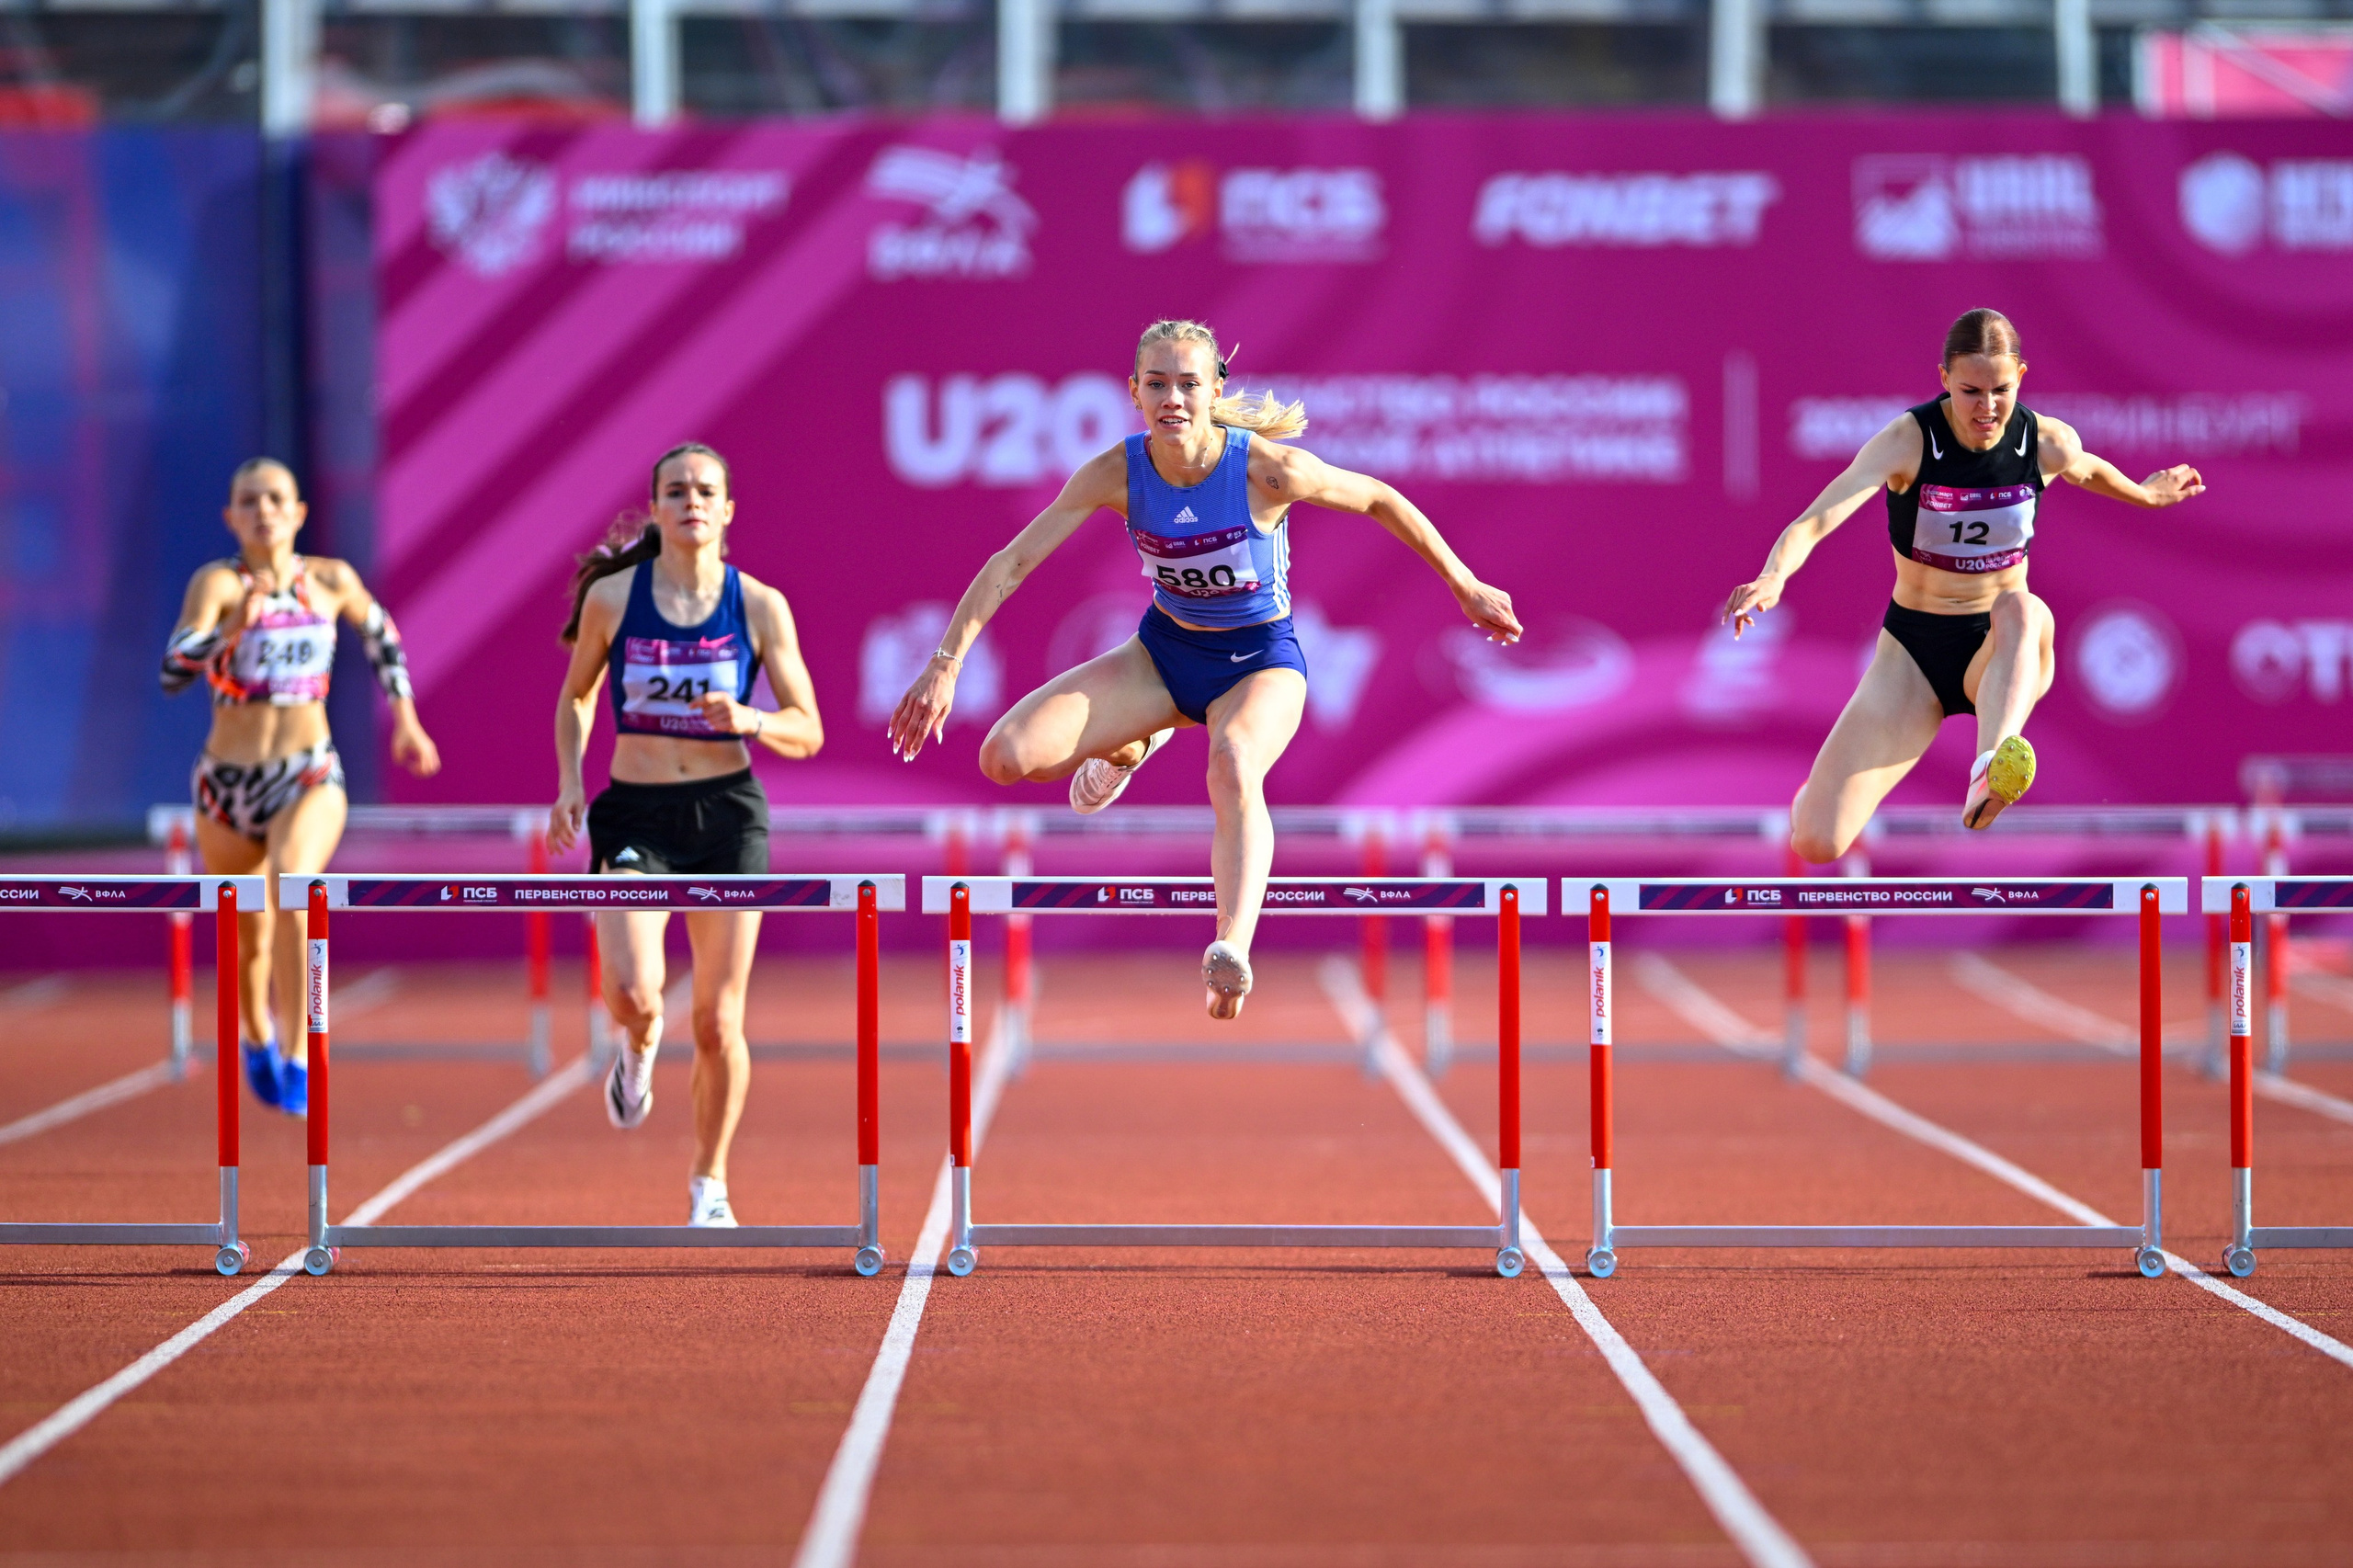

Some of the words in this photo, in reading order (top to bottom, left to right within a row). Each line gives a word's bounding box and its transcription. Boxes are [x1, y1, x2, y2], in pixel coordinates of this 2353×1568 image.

[1474, 172, 1776, 244] FONBET
[884, 377, 1127, 485] U20
[1174, 516, 1199, 524] adidas
[1949, 521, 1990, 545] 12
[1955, 558, 1985, 571] U20
[1156, 564, 1236, 588] 580
[647, 676, 710, 703] 241
[95, 890, 127, 899] ВФЛА
[463, 887, 498, 899] ПСБ
[515, 889, 607, 900] ПЕРВЕНСТВО
[609, 890, 668, 900] РОССИИ
[724, 890, 755, 898] ВФЛА
[1120, 888, 1154, 900] ПСБ
[1171, 891, 1216, 901] ПЕРВЕ
[1266, 891, 1325, 901] РОССИИ
[1380, 891, 1411, 899] ВФЛА
[1747, 889, 1782, 902] ПСБ
[1798, 891, 1891, 902] ПЕРВЕНСТВО
[1893, 891, 1953, 902] РОССИИ
[2008, 891, 2039, 899] ВФЛА
[311, 963, 324, 1016] polanik
[953, 964, 967, 1016] polanik
[1593, 966, 1607, 1017] polanik
[2234, 966, 2247, 1017] polanik
